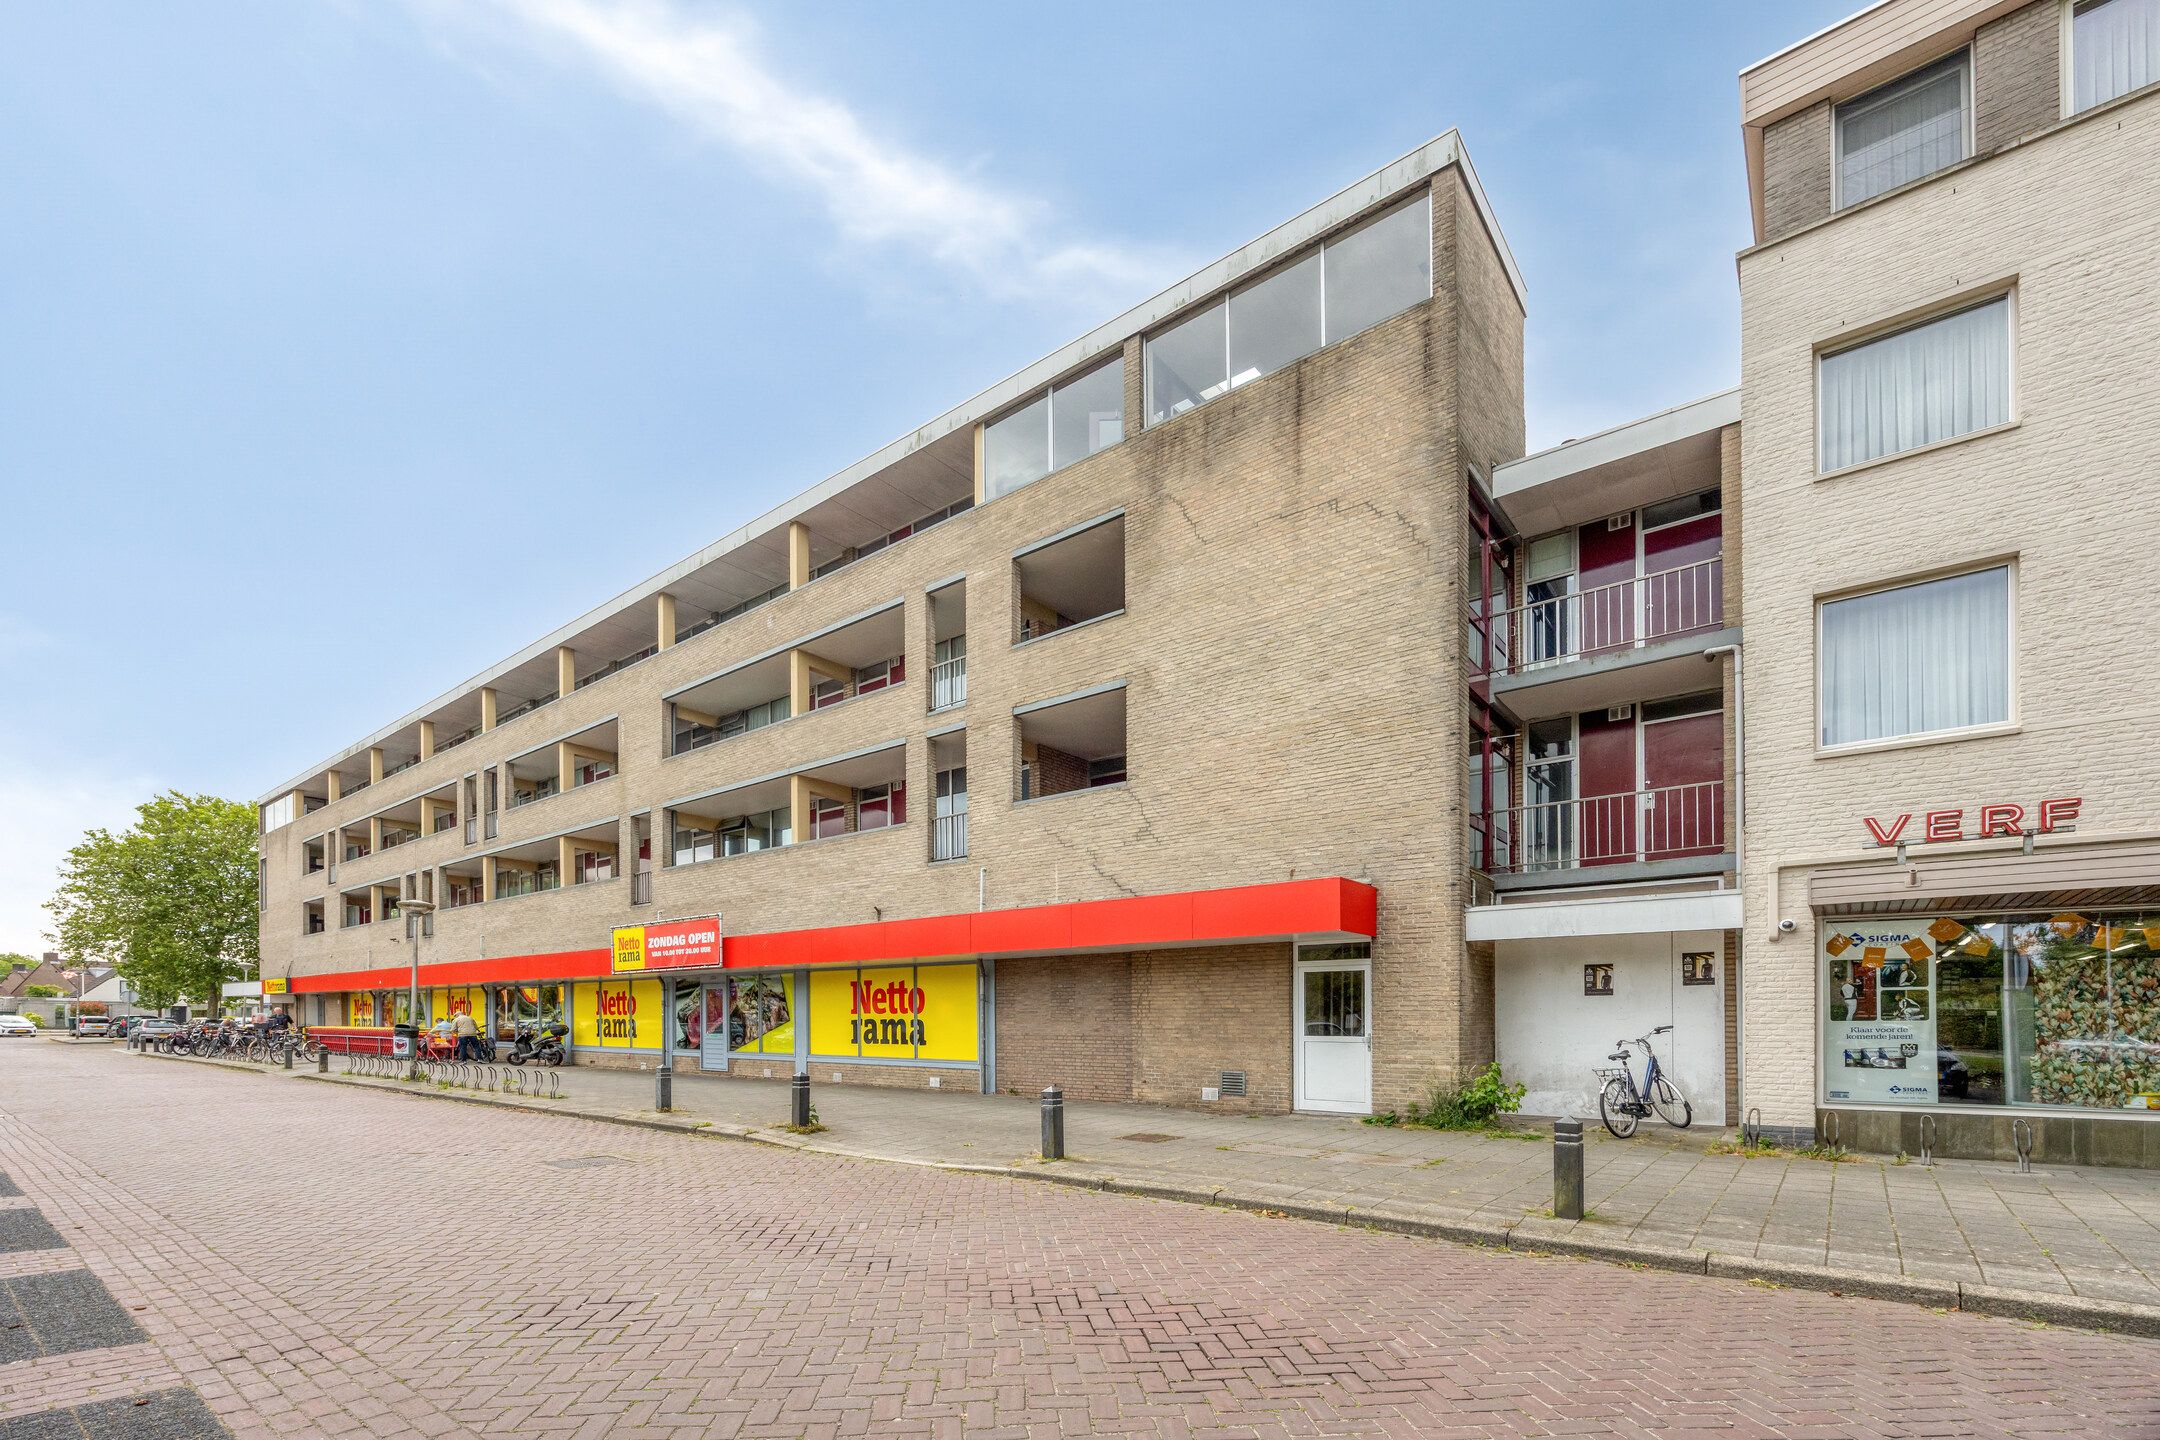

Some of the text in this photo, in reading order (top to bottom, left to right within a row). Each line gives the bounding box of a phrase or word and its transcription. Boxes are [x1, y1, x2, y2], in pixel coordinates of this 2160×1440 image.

[1863, 797, 2082, 847] VERF
[618, 937, 640, 951] Netto
[648, 931, 715, 949] ZONDAG OPEN
[1868, 934, 1911, 943] SIGMA
[618, 951, 640, 963] rama
[446, 995, 472, 1016] Netto
[595, 989, 637, 1016] Netto
[850, 980, 925, 1014] Netto
[354, 998, 372, 1016] Netto
[596, 1018, 637, 1038] rama
[850, 1018, 926, 1045] rama
[1888, 1033, 1913, 1041] jaren!
